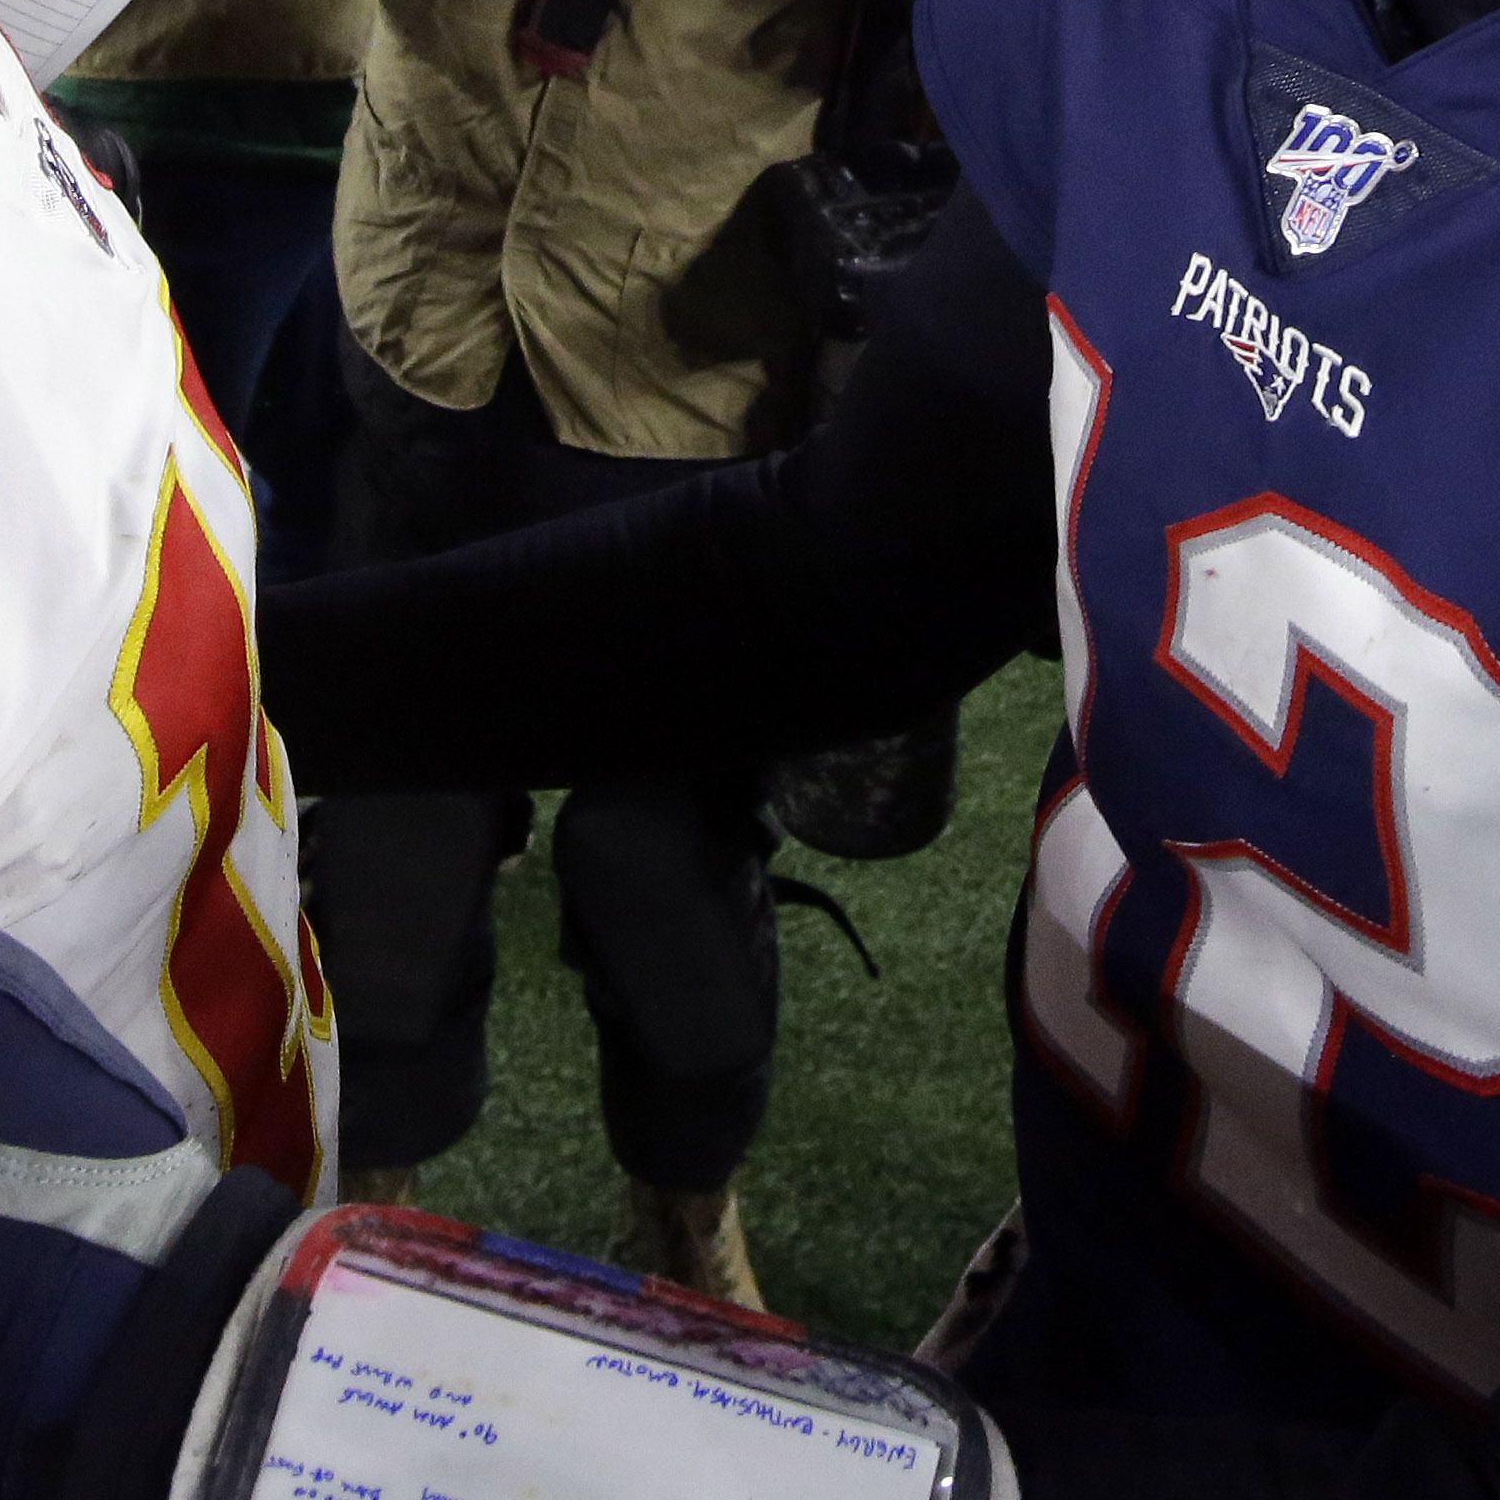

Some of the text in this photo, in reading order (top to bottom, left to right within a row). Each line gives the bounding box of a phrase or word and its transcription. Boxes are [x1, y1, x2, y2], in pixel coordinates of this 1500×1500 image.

[1285, 112, 1388, 197] 100
[1293, 201, 1331, 239] NFL
[1171, 252, 1373, 438] PATRIOTS
[837, 1428, 917, 1470] ENERGY
